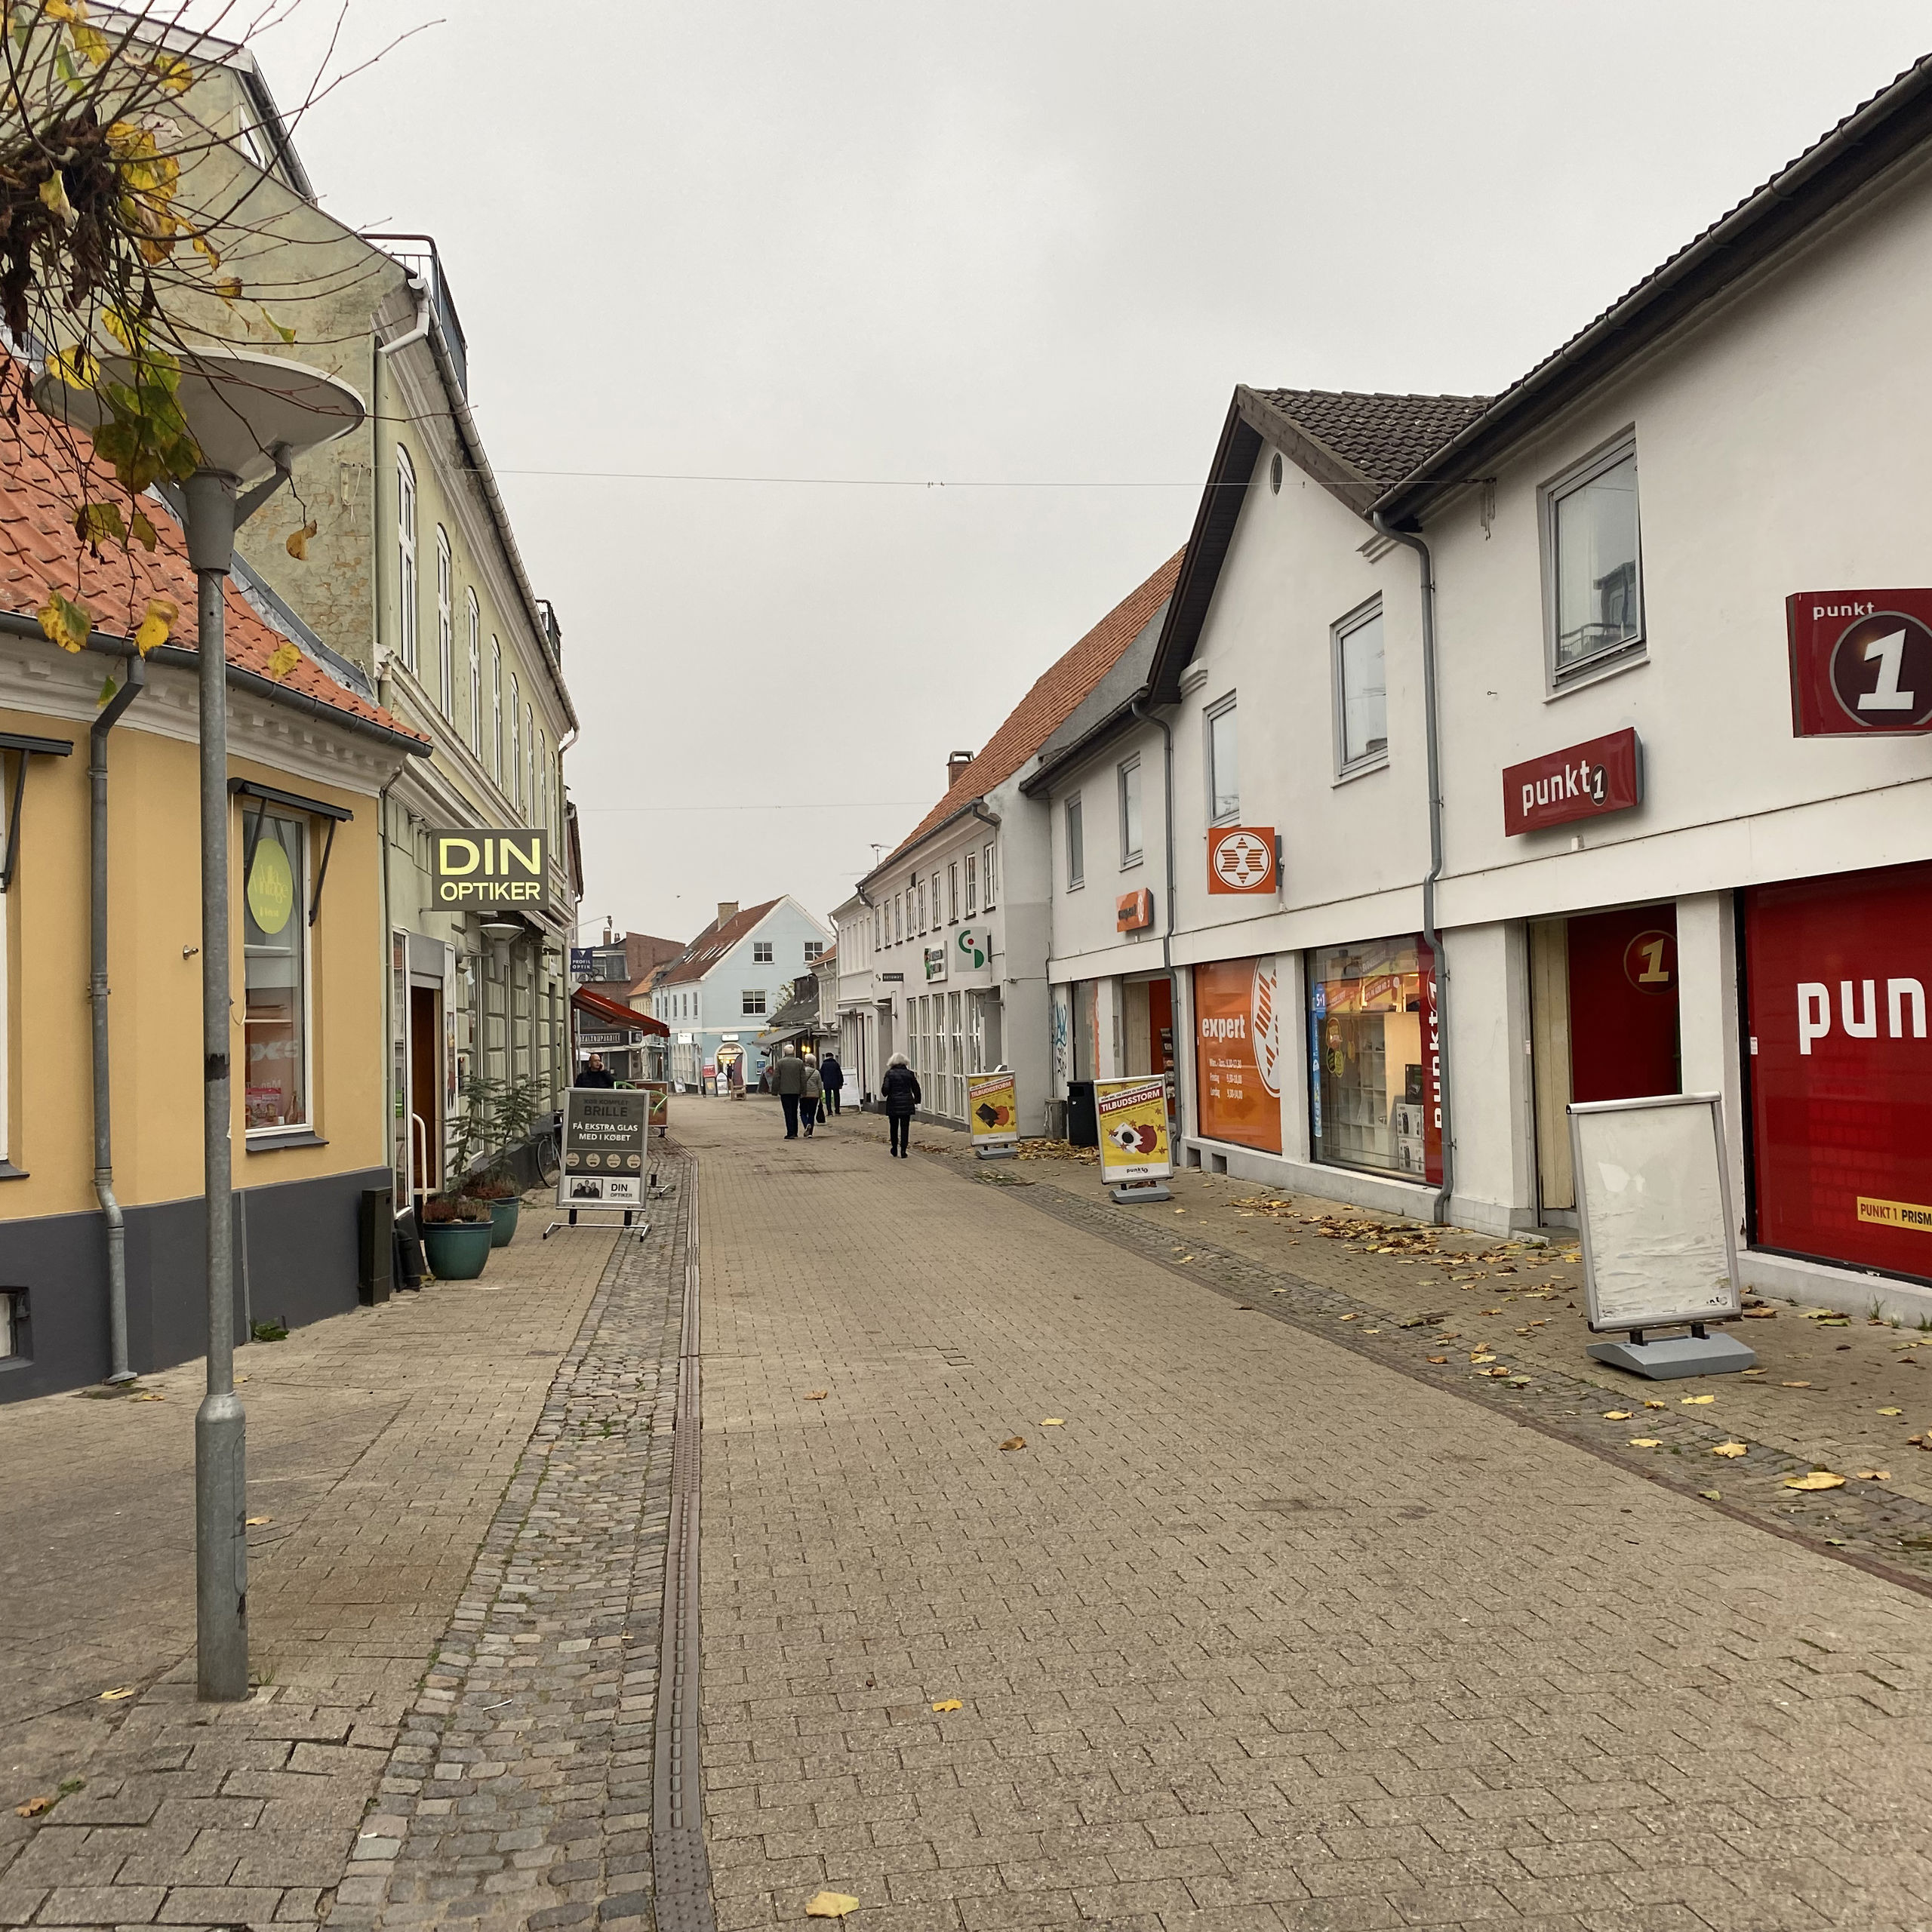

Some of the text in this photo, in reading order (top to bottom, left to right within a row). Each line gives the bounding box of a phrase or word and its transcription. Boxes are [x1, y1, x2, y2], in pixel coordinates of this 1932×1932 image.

[1813, 602, 1875, 620] punkt
[1857, 628, 1915, 710] 1
[439, 838, 541, 875] DIN
[440, 881, 541, 901] OPTIKER
[1638, 938, 1669, 983] 1
[1797, 977, 1927, 1055] pun
[1202, 1014, 1246, 1043] expert
[971, 1081, 1011, 1098] TILBUDSSTORM
[1101, 1089, 1161, 1112] TILBUDSSTORM
[584, 1105, 628, 1117] BRILLE
[573, 1121, 583, 1130] FÅ
[611, 1183, 629, 1192] DIN
[1860, 1203, 1932, 1226] PUNKT 1 PRISM
